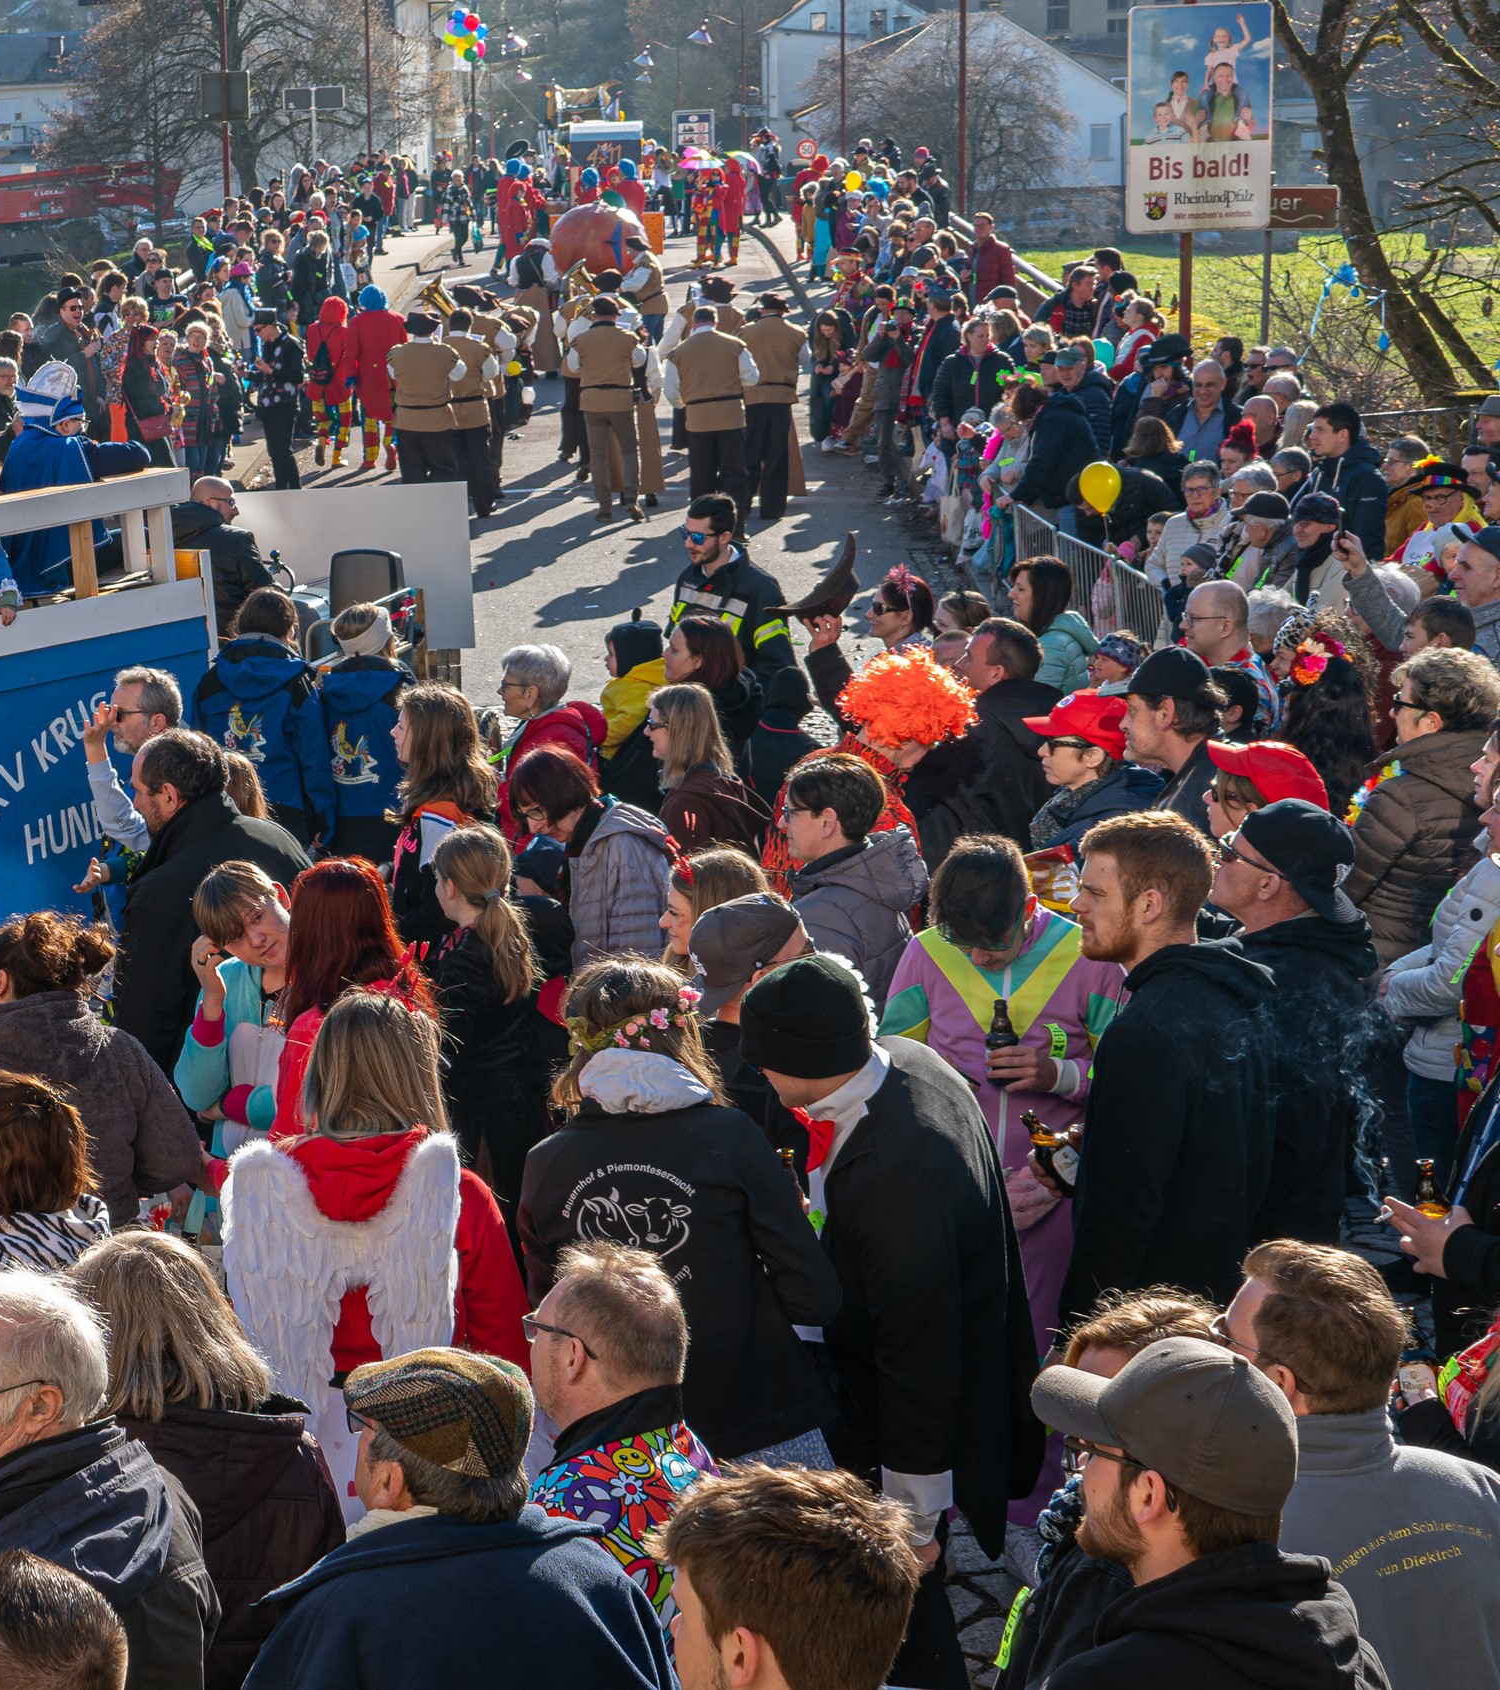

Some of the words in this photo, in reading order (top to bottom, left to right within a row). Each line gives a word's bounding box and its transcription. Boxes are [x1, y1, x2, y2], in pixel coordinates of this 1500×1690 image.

[801, 144, 813, 155] 50
[1149, 155, 1183, 180] Bis
[1192, 152, 1250, 178] bald!
[1173, 212, 1186, 220] Wir
[1188, 210, 1223, 220] machen's
[561, 1172, 595, 1219] Bauernhof
[596, 1168, 606, 1178] &
[606, 1163, 697, 1198] Piemonteserzucht
[1368, 1534, 1387, 1551] aus
[1388, 1527, 1412, 1541] dem
[1375, 1563, 1399, 1577] vun
[1402, 1544, 1462, 1571] Diekirch
